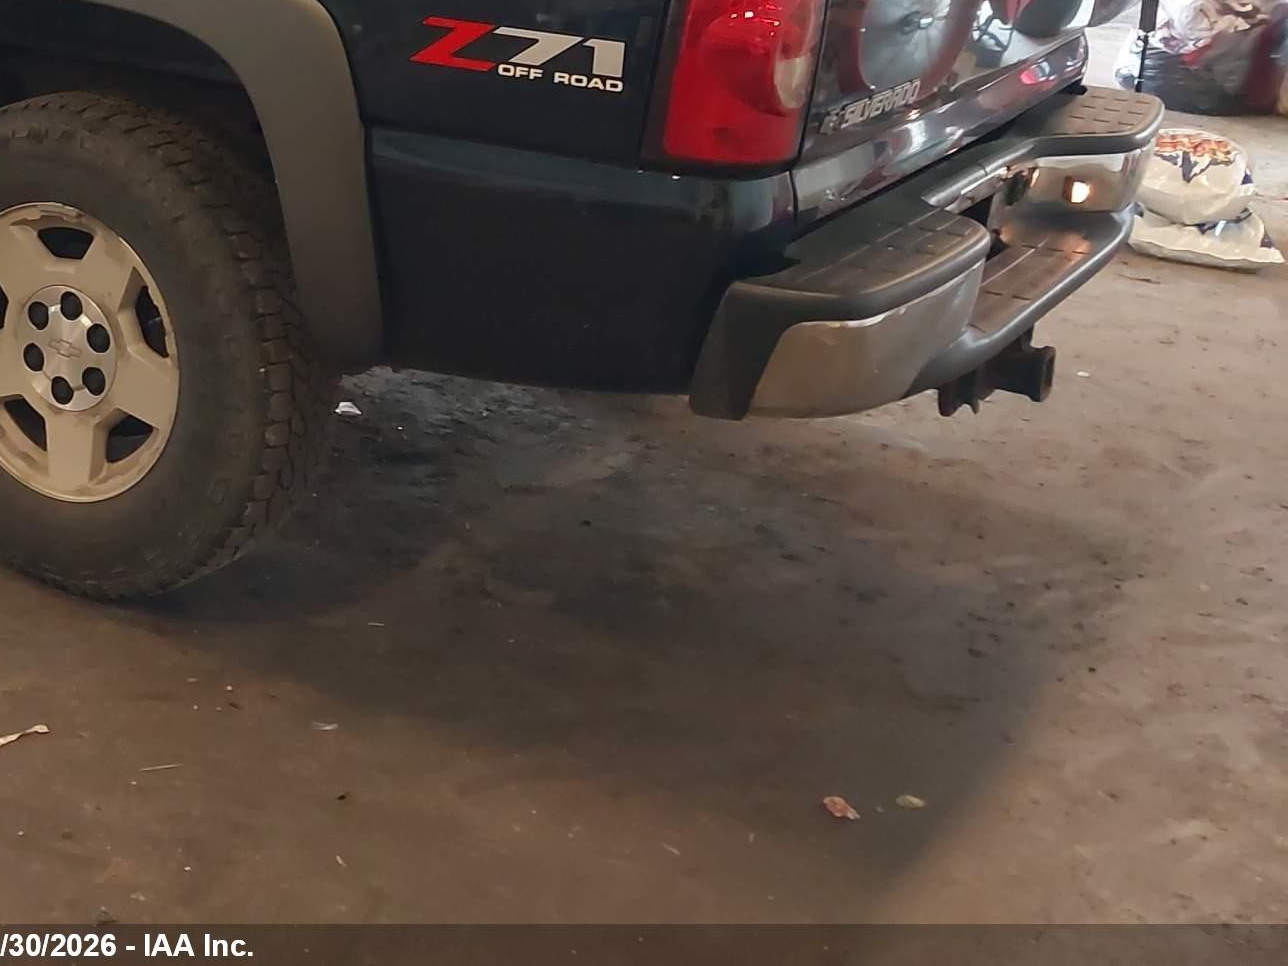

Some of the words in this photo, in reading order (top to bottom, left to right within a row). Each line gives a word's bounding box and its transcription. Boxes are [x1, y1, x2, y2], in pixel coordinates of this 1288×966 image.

[409, 15, 626, 78] Z71
[497, 63, 544, 80] OFF
[553, 71, 624, 93] ROAD
[840, 78, 922, 130] SILVERADO
